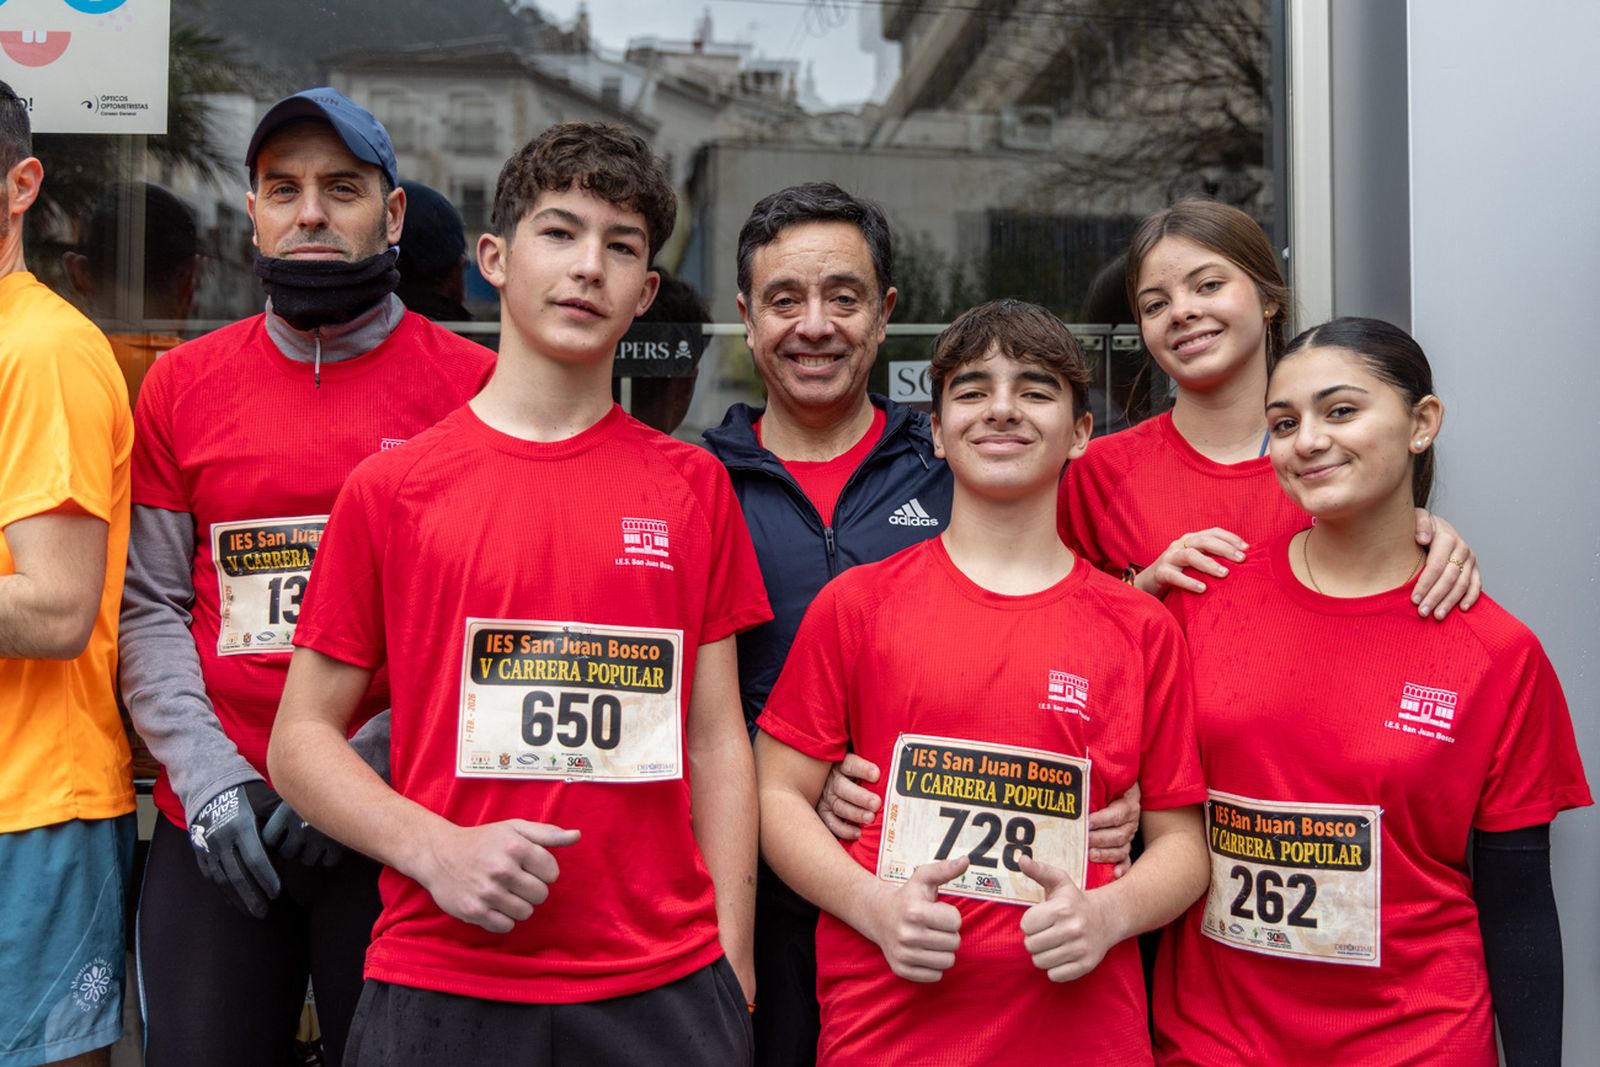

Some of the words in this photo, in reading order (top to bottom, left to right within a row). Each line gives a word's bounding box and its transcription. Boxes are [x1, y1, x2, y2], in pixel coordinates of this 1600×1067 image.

[101, 94, 128, 102] ÓPTICOS
[615, 341, 671, 360] PERS
[888, 514, 939, 526] adidas
[230, 533, 253, 551] IES
[257, 530, 286, 548] San
[226, 555, 238, 572] V
[243, 549, 310, 571] CARRERA
[631, 558, 644, 566] San
[486, 634, 514, 654] IES
[520, 635, 555, 655] San
[560, 635, 602, 657] Juan
[608, 639, 660, 661] Bosco
[480, 657, 493, 680] V
[499, 659, 581, 682] CARRERA
[588, 661, 665, 688] POPULAR
[521, 690, 622, 750] 650
[1064, 706, 1079, 714] Juan
[1402, 724, 1416, 733] San
[1418, 728, 1435, 738] Juan
[911, 747, 937, 768] IES
[942, 751, 974, 773] San
[979, 755, 1022, 779] Juan
[1027, 761, 1073, 786] Bosco
[905, 770, 918, 791] V
[920, 772, 997, 803] CARRERA
[1003, 783, 1076, 814] POPULAR
[212, 797, 239, 820] SAN
[1215, 806, 1229, 825] IES
[1231, 809, 1250, 831] San
[1254, 814, 1295, 835] Juan
[1301, 817, 1357, 838] Bosco
[934, 806, 1036, 872] 728
[1212, 827, 1219, 847] V
[1219, 828, 1276, 860] CARRERA
[1280, 841, 1363, 866] POPULAR
[1230, 865, 1318, 929] 262
